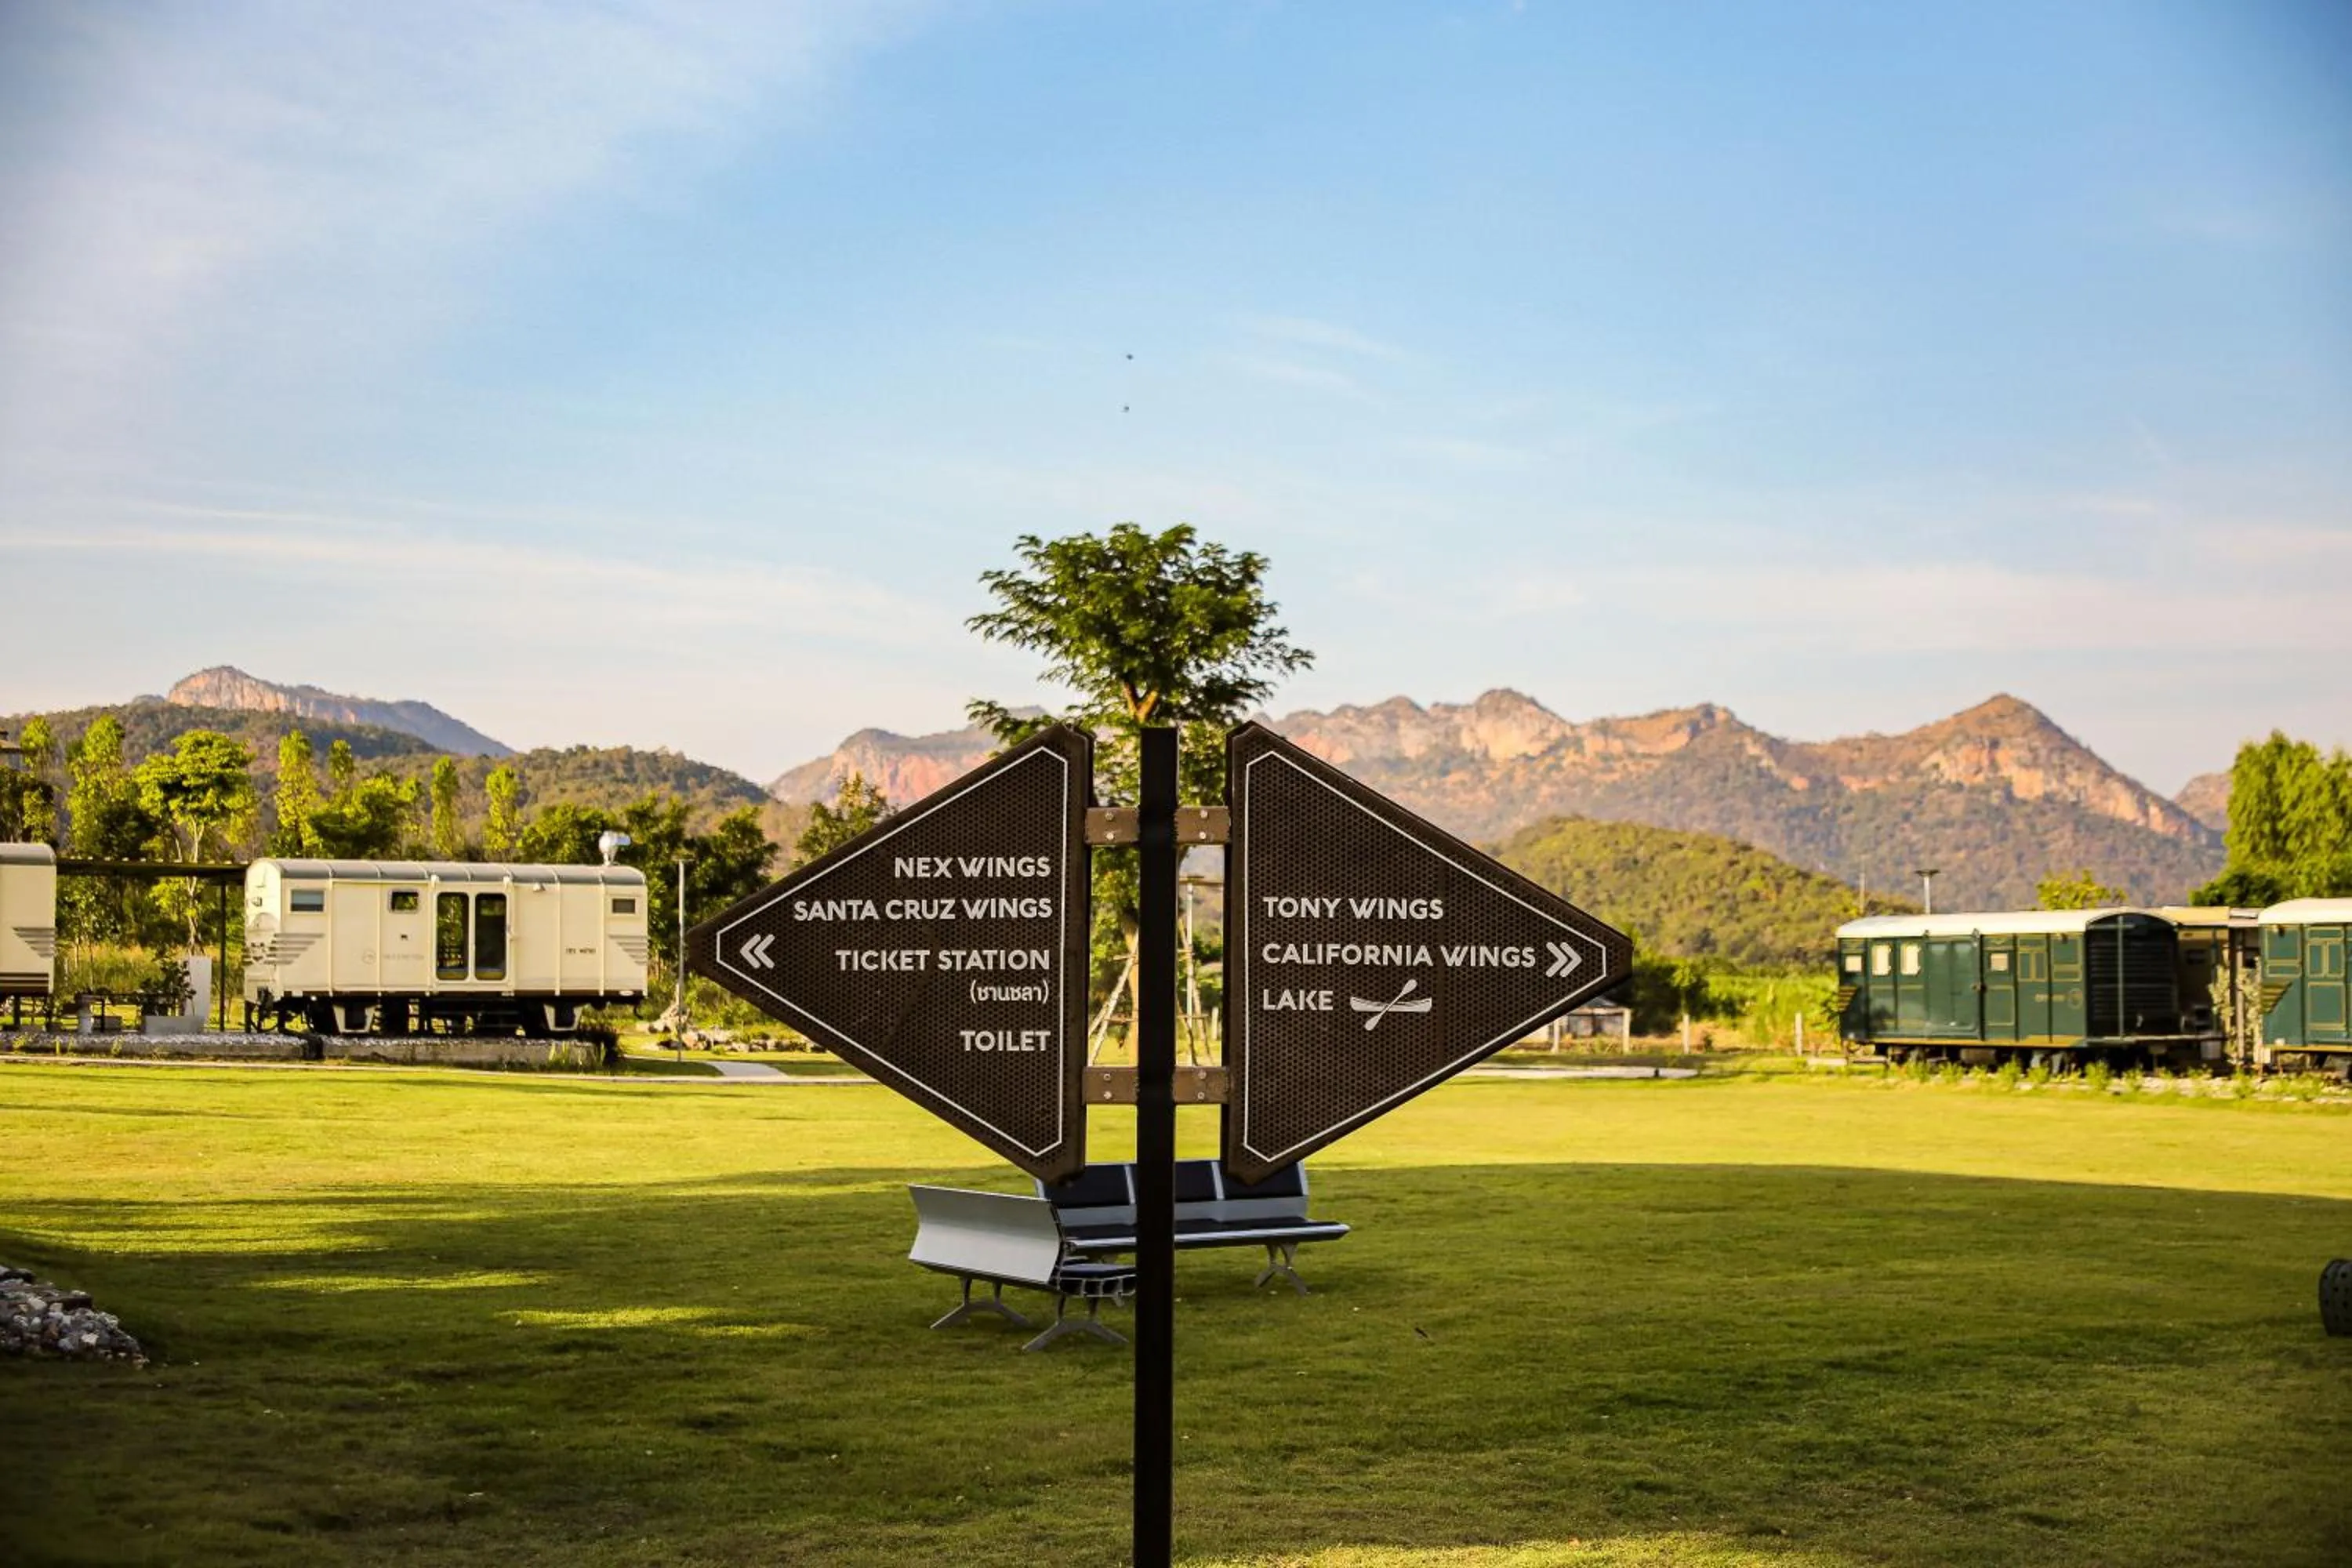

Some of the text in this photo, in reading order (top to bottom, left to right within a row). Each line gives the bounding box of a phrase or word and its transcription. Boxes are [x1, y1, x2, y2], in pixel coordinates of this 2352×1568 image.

[895, 856, 1051, 878] NEX WINGS
[794, 898, 1053, 921] SANTA CRUZ WINGS
[1262, 896, 1443, 920] TONY WINGS
[835, 949, 1050, 971] TICKET STATION
[1261, 942, 1536, 968] CALIFORNIA WINGS
[970, 979, 1049, 1004] (ชานชลา)
[1263, 989, 1334, 1011] LAKE
[960, 1030, 1051, 1051] TOILET
